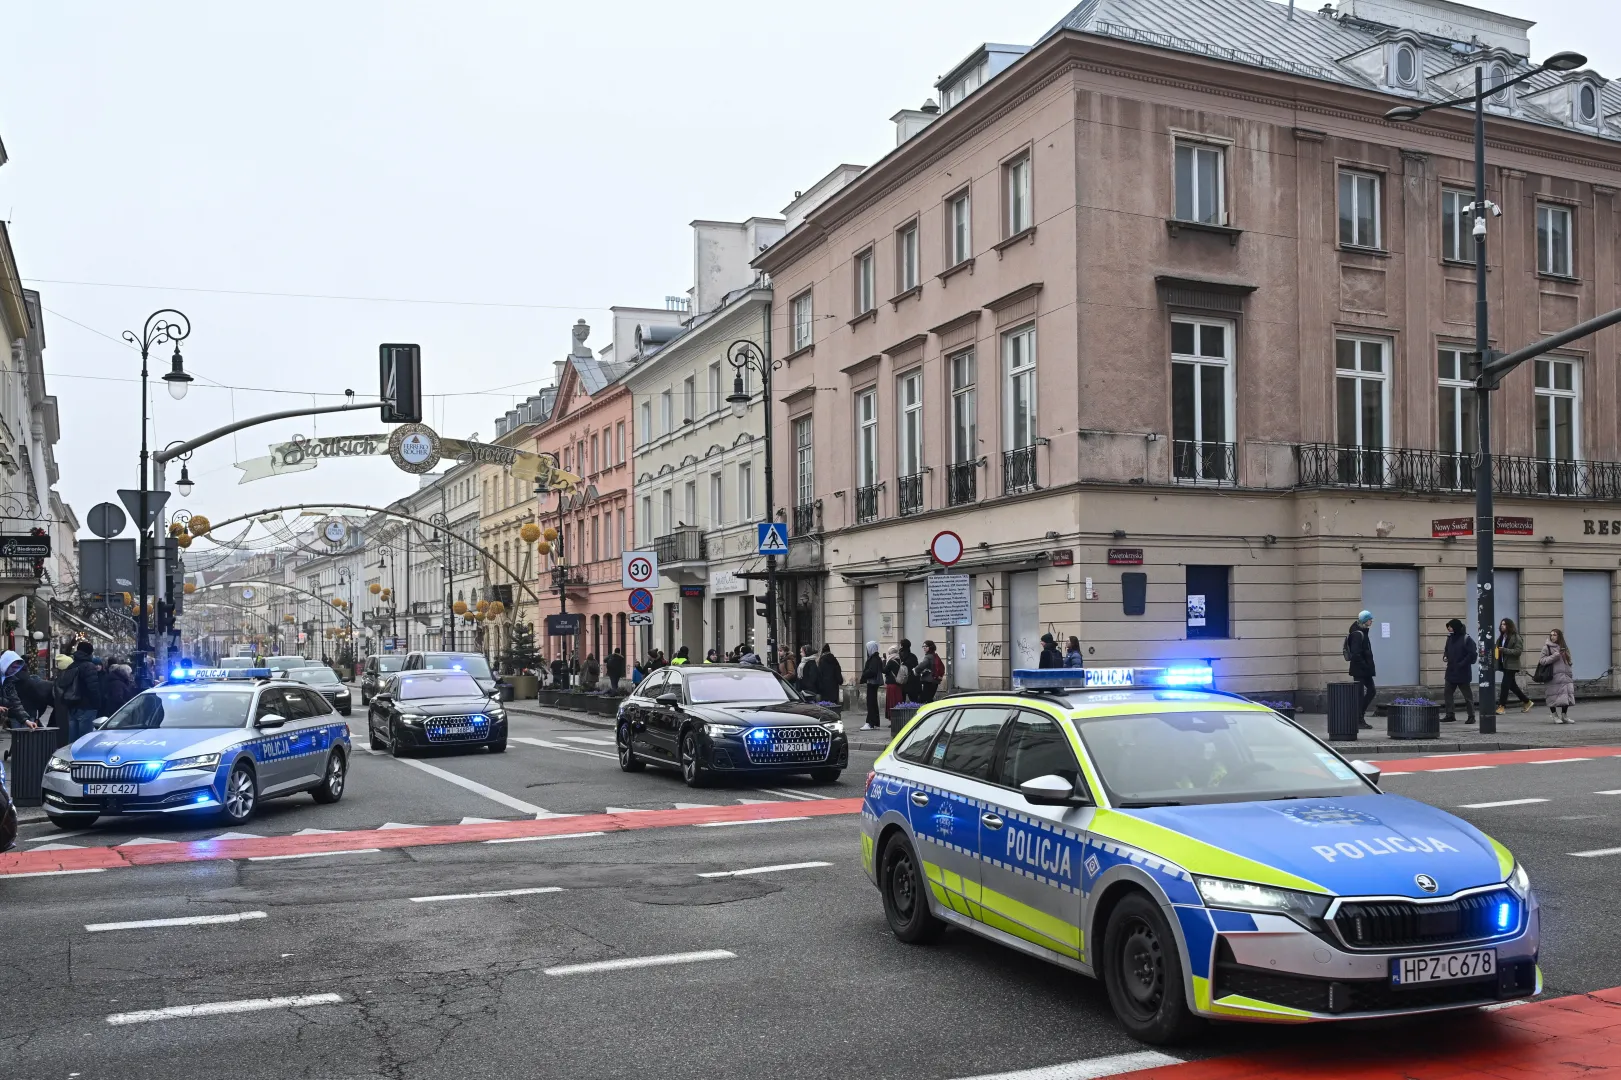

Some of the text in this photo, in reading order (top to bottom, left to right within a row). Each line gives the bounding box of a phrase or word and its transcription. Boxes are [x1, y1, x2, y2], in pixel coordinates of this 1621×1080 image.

[1434, 521, 1468, 532] Nowy Świat
[1496, 519, 1533, 530] Świętokrzyska
[1583, 519, 1621, 535] RES
[1109, 550, 1143, 561] Świętokrzyska
[631, 564, 649, 576] 30
[195, 669, 227, 677] POLICJA
[1086, 669, 1133, 685] POLICJA
[93, 740, 167, 748] POLICJA
[262, 739, 291, 759] POLICJA
[774, 742, 810, 752] WN 2301T
[89, 784, 136, 794] HPZ C427
[1006, 826, 1072, 880] POLICJA
[1311, 836, 1460, 863] POLICJA
[1404, 952, 1492, 982] HPZ C678
